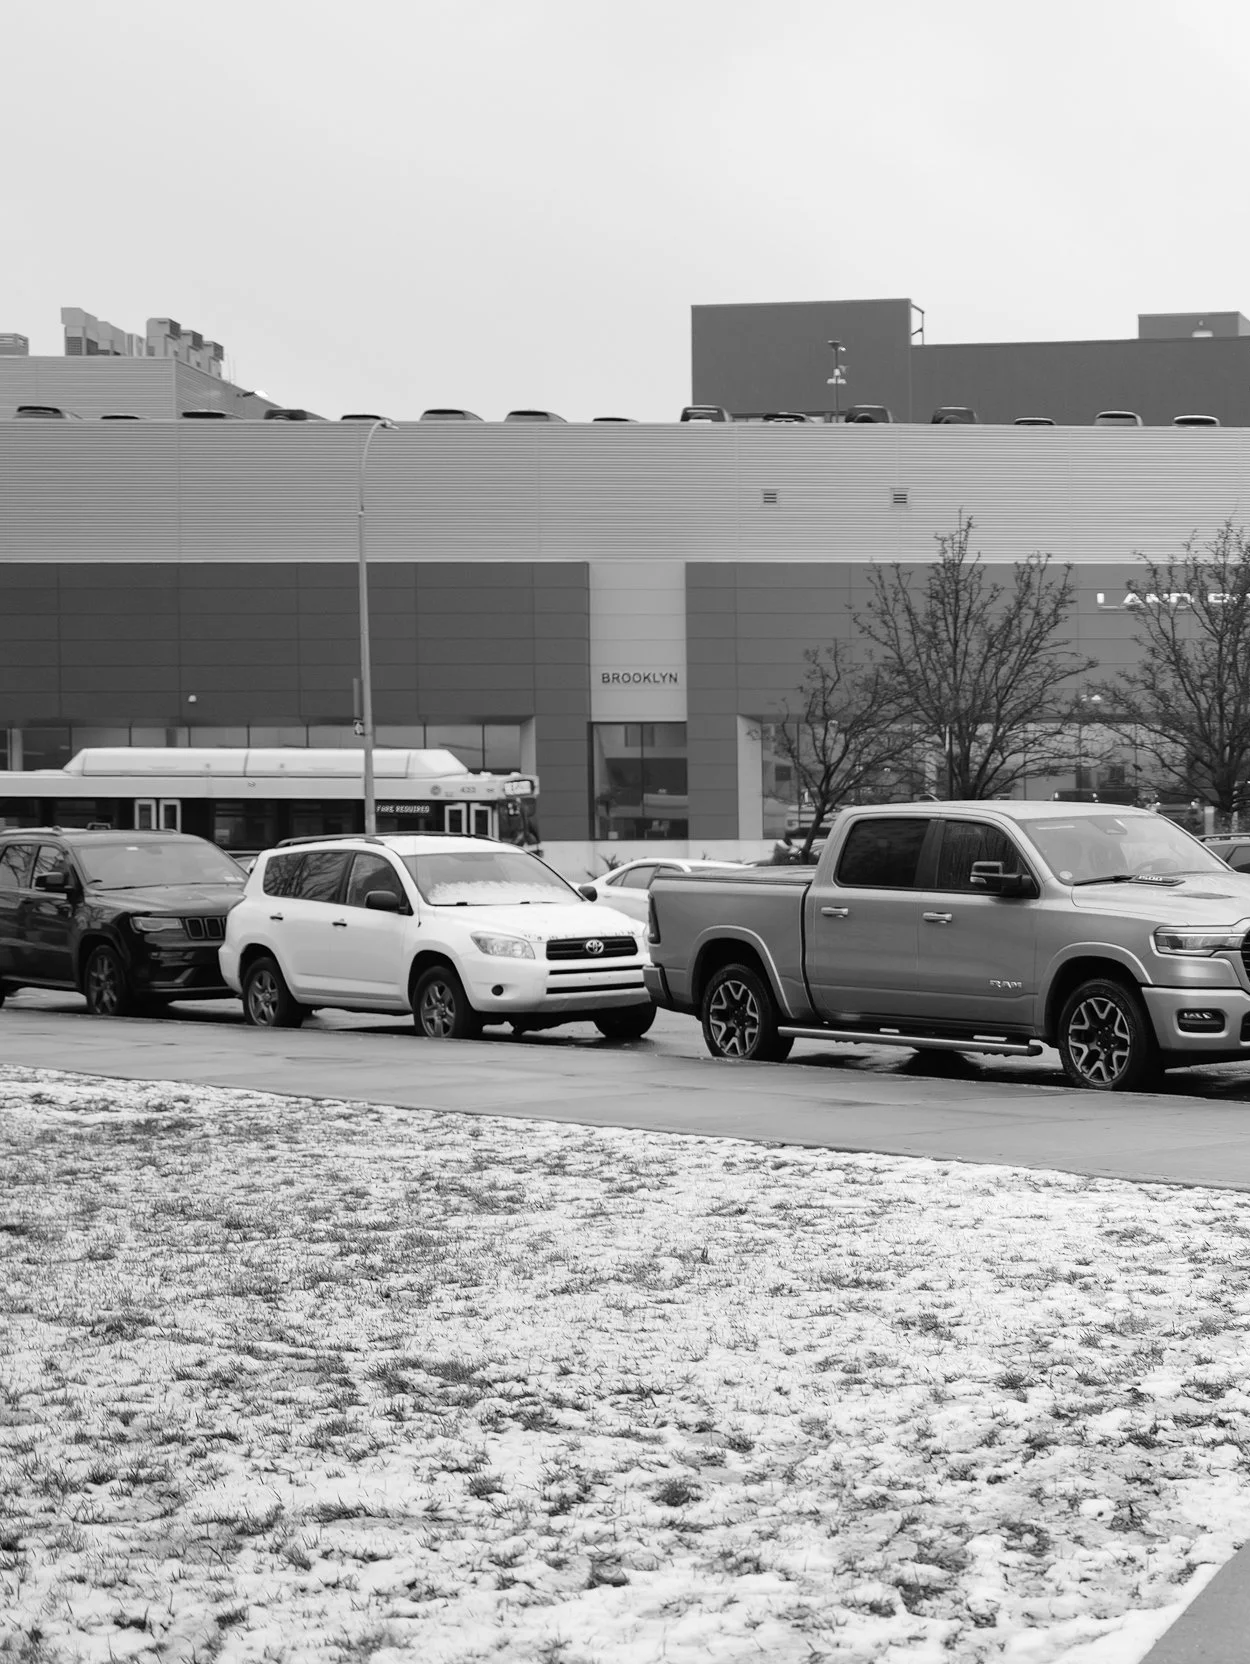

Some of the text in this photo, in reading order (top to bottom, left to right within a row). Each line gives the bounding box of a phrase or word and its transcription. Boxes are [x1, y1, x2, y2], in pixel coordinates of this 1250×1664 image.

[601, 672, 679, 684] BROOKLYN
[376, 804, 430, 814] FARE REQUIRED
[989, 979, 1022, 989] RAM
